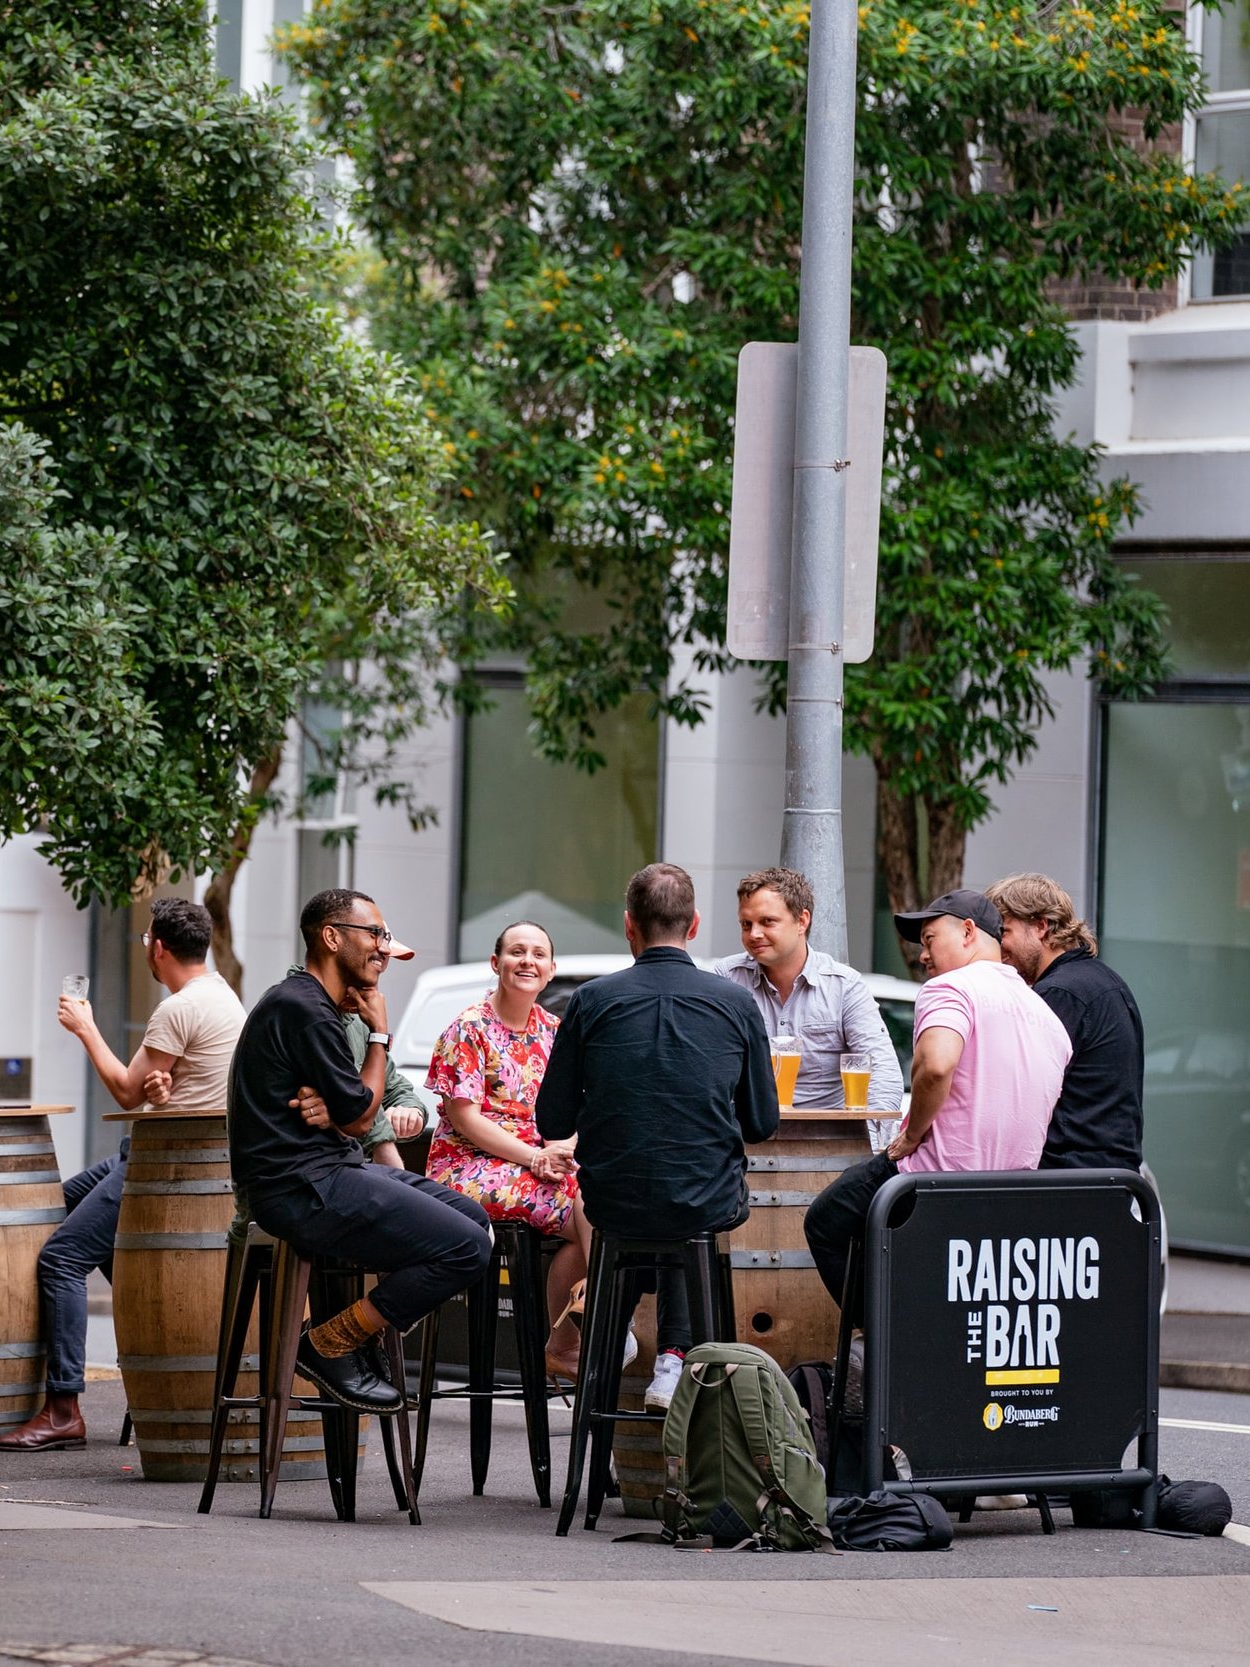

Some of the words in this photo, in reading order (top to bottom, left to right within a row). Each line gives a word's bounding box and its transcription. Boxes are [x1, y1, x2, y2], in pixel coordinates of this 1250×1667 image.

[947, 1236, 1100, 1302] RAISING
[968, 1311, 982, 1364] THE
[985, 1304, 1061, 1368] BAR
[1004, 1404, 1058, 1424] BUNDABERG
